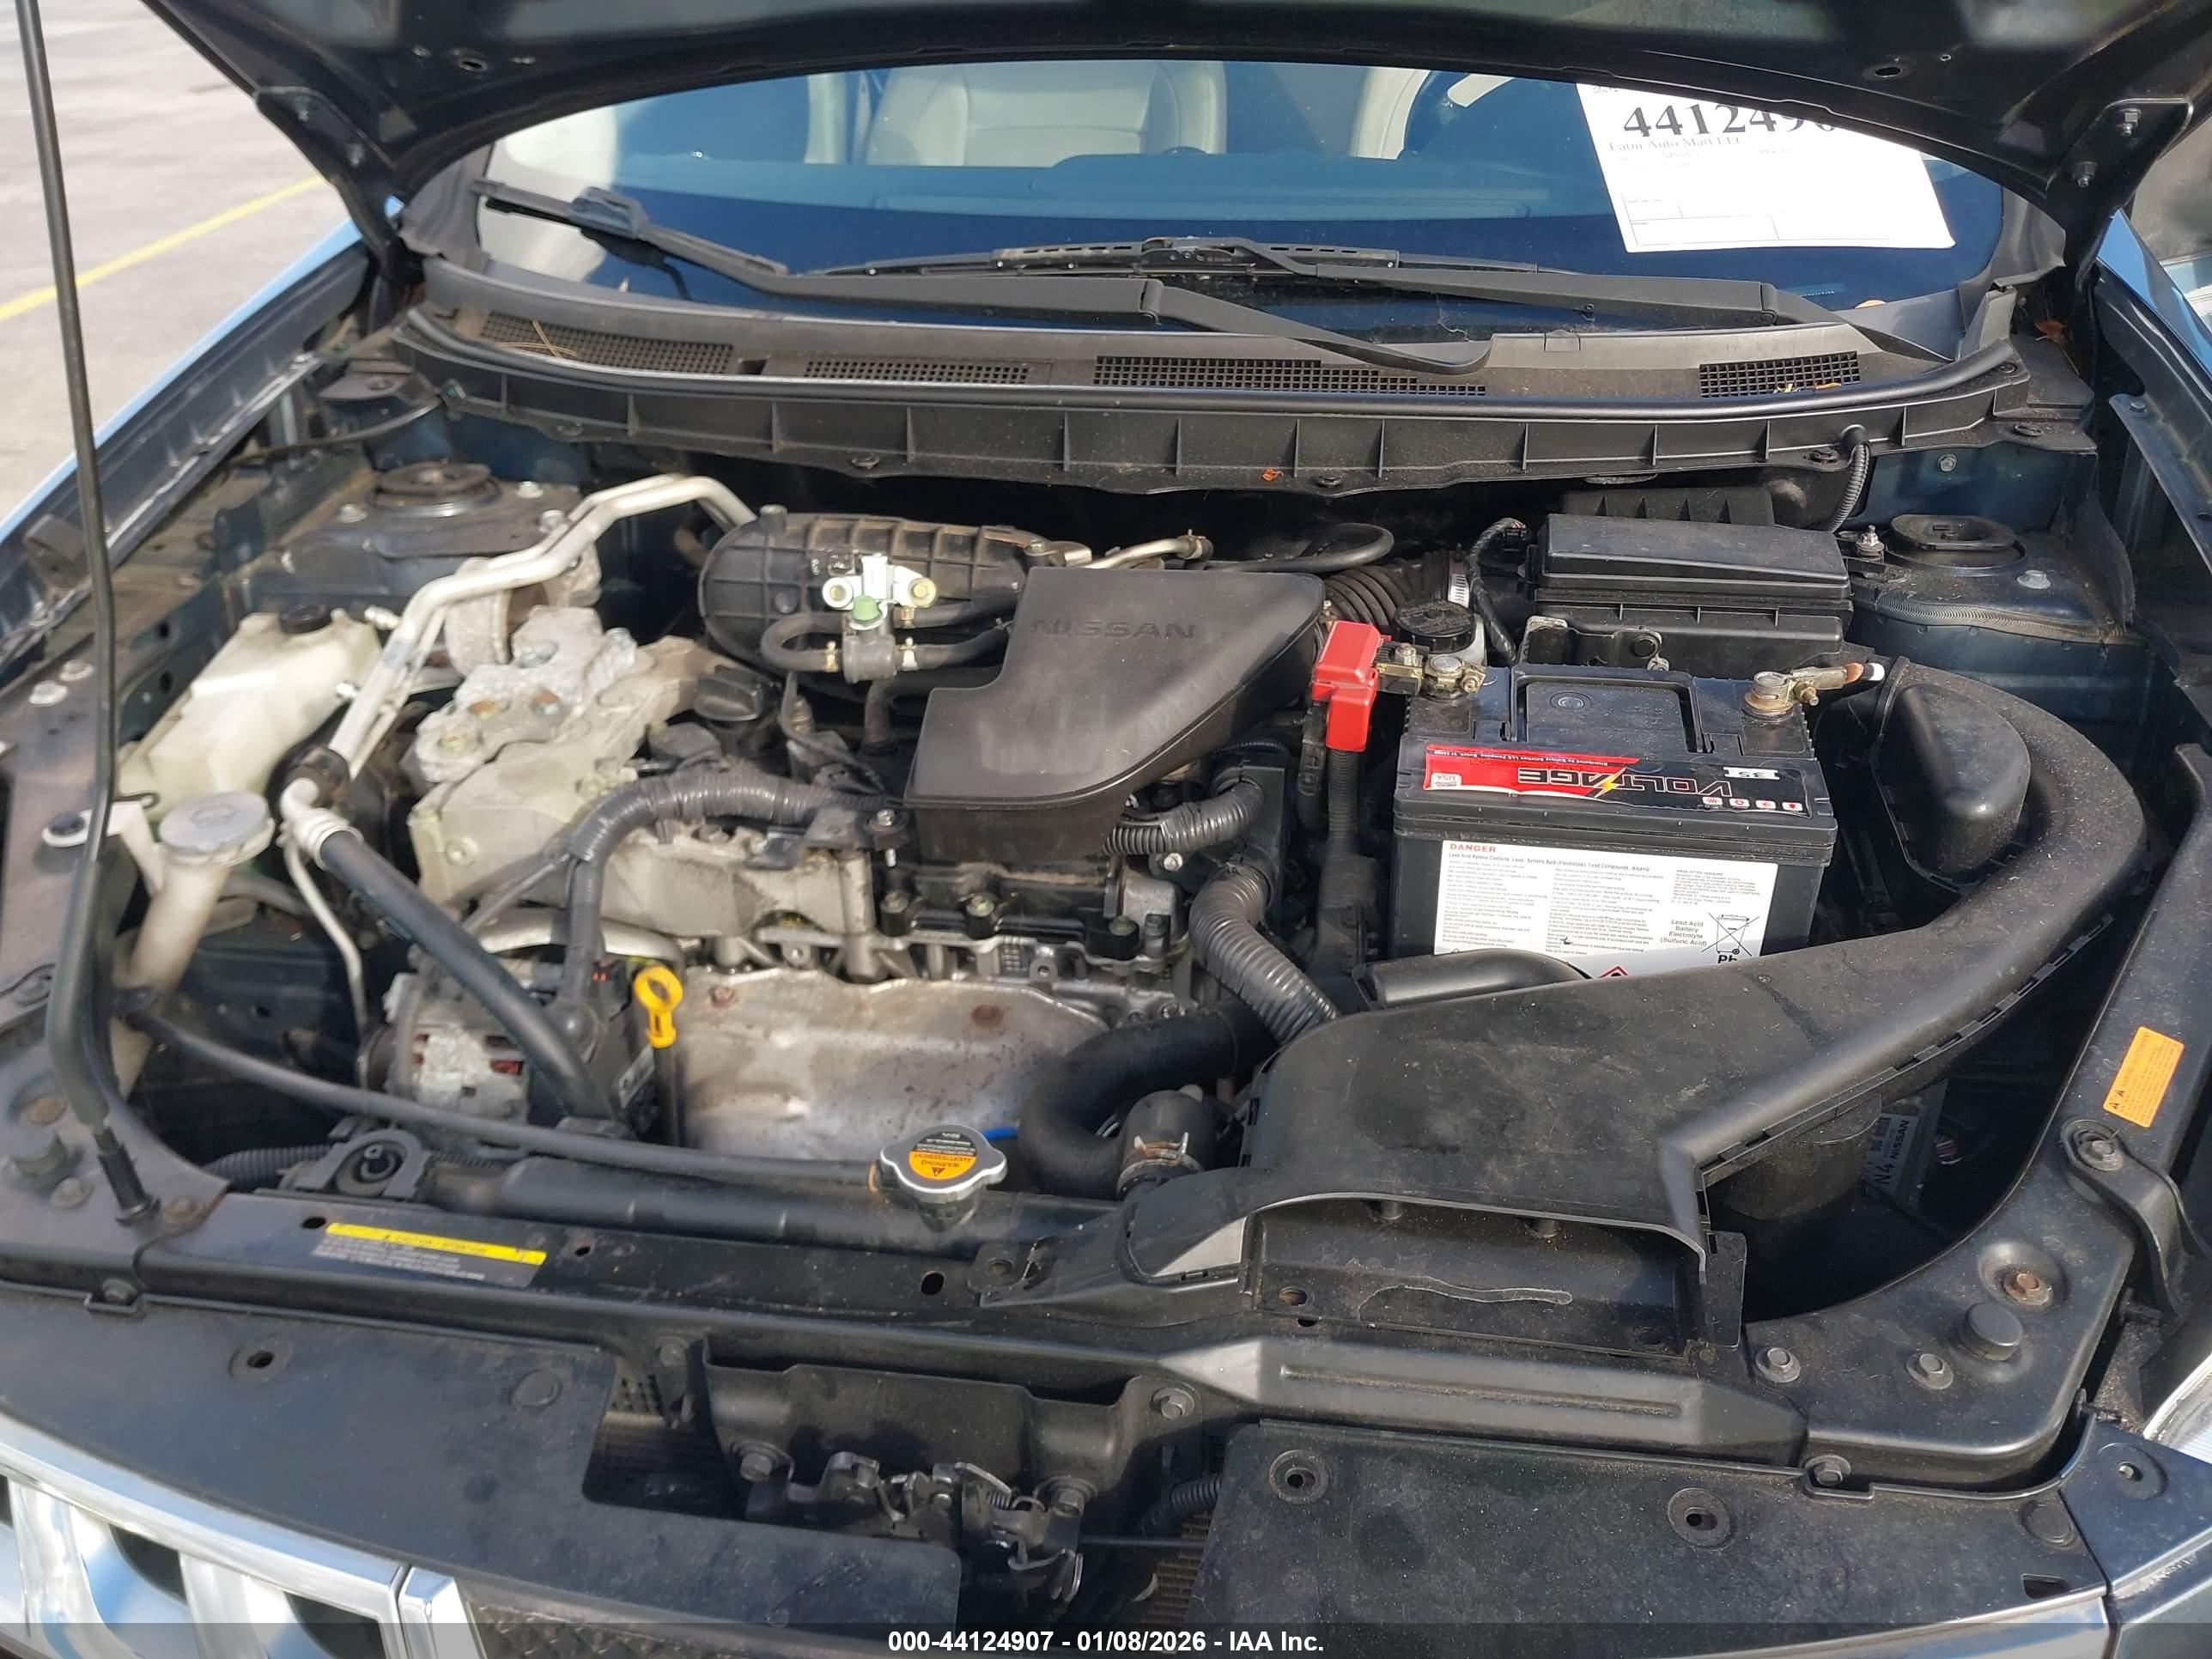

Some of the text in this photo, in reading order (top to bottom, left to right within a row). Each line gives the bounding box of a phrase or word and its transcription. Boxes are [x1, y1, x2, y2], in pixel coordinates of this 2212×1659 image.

[1646, 138, 1680, 150] Auto
[1682, 137, 1713, 149] Mart
[1030, 619, 1196, 641] NISSAN
[1516, 766, 1733, 798] VOLTAGE
[1449, 843, 1497, 854] DANGER
[1668, 931, 1704, 939] Electrolyte
[1889, 1119, 1910, 1160] NISSAN
[921, 1159, 960, 1169] WARNING
